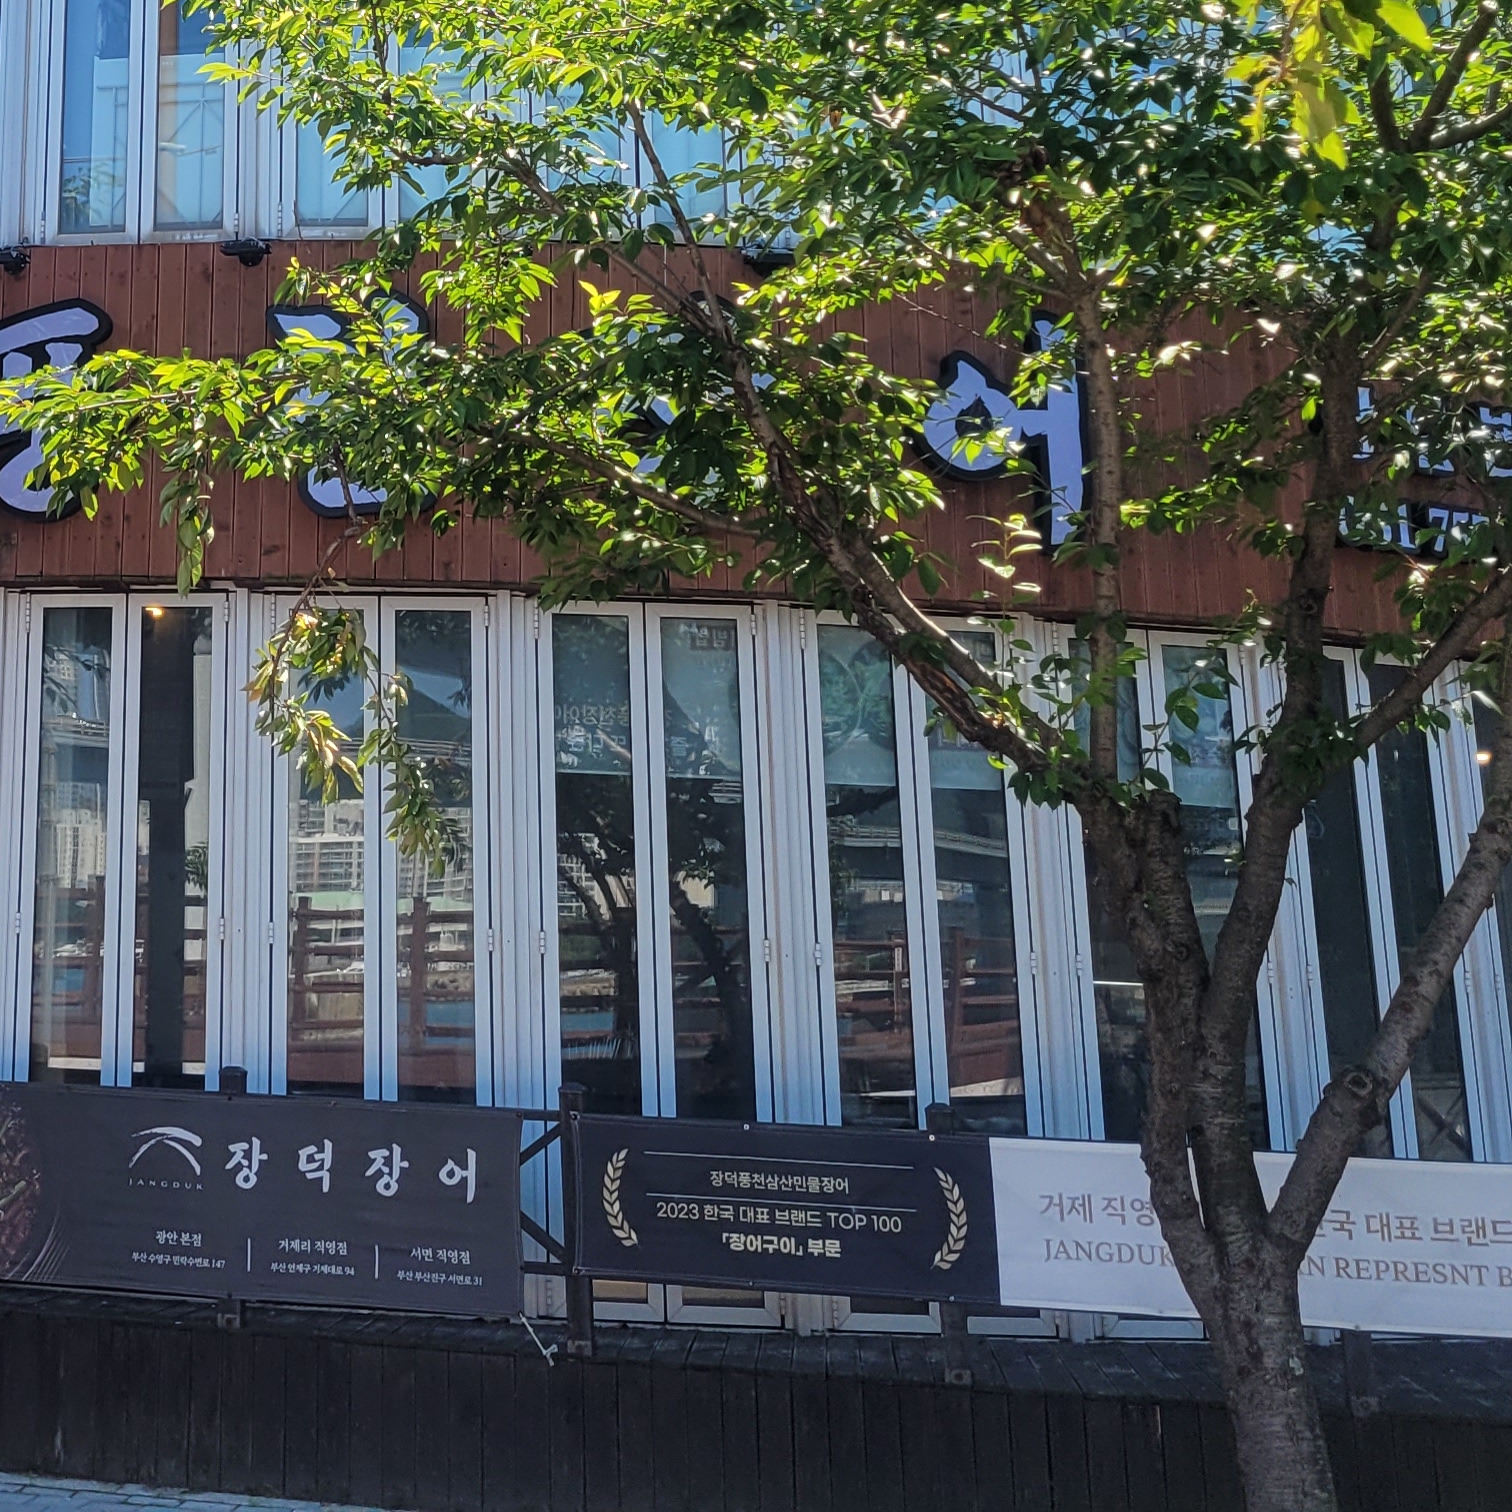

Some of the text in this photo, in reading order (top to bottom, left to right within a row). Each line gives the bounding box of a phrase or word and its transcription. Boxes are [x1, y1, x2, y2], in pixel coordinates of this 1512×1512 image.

[128, 1176, 204, 1191] JANGDUK
[709, 1170, 850, 1194] 장덕풍천삼산민물장어
[656, 1201, 902, 1233] 2023 한국 대표 브랜드 TOP 100
[1039, 1193, 1512, 1247] 거제 직영 국 대표 브랜드
[155, 1229, 202, 1248] 광안 본점
[277, 1237, 348, 1256] 거제리 직영점
[807, 1238, 842, 1258] 부문
[131, 1251, 147, 1264] 부산
[410, 1247, 471, 1265] 서면 직영점
[1044, 1238, 1175, 1267] JANGDUK
[1333, 1256, 1490, 1287] REPRESNT
[270, 1261, 286, 1273] 부산
[344, 1266, 355, 1276] 94
[396, 1270, 413, 1281] 부산
[473, 1276, 483, 1286] 31
